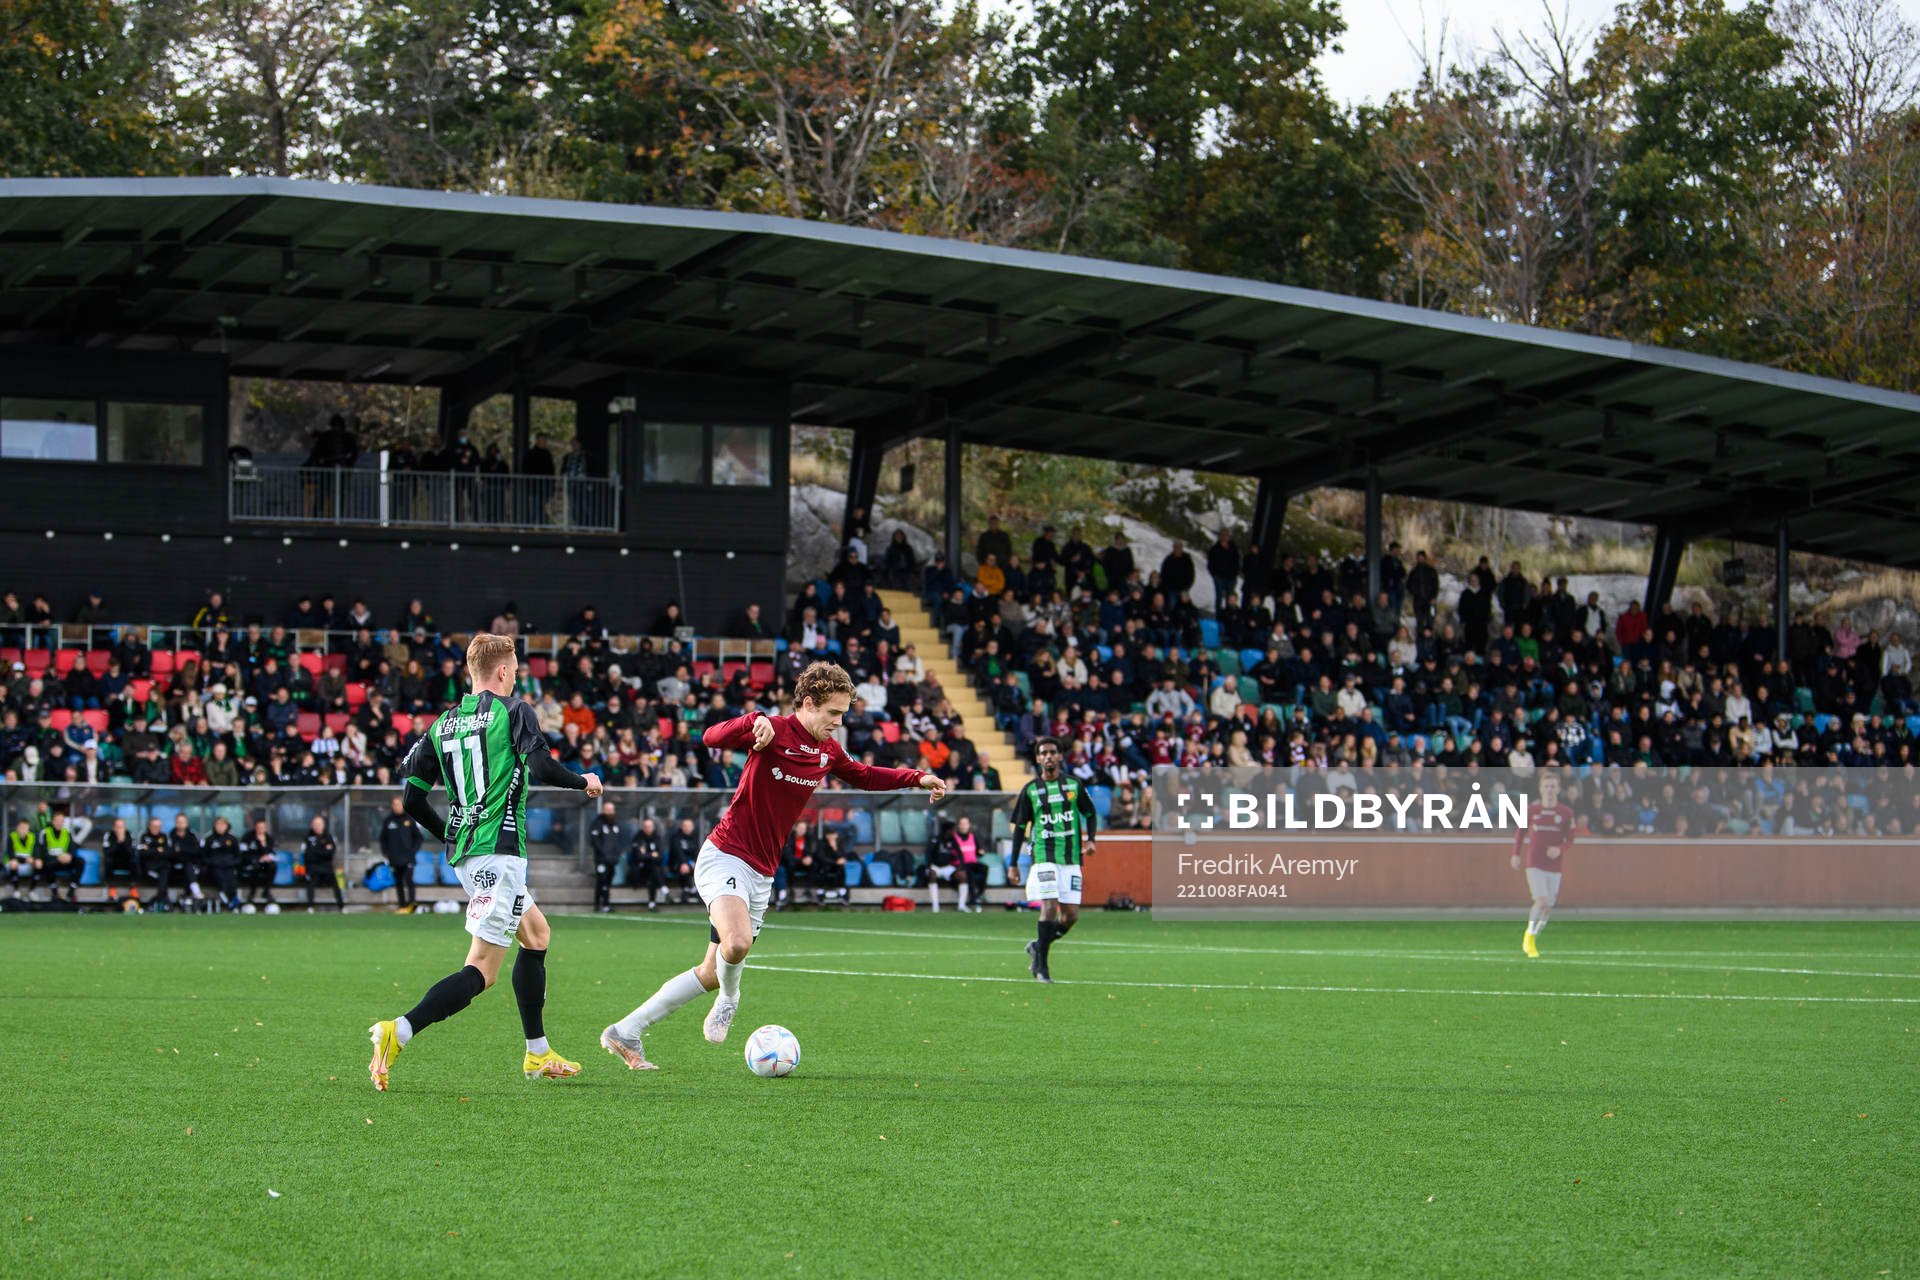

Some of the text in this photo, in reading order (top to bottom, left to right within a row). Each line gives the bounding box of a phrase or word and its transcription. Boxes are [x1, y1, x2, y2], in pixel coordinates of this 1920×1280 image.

[441, 734, 486, 807] 11
[1039, 810, 1075, 825] JUNI
[726, 877, 737, 890] 4
